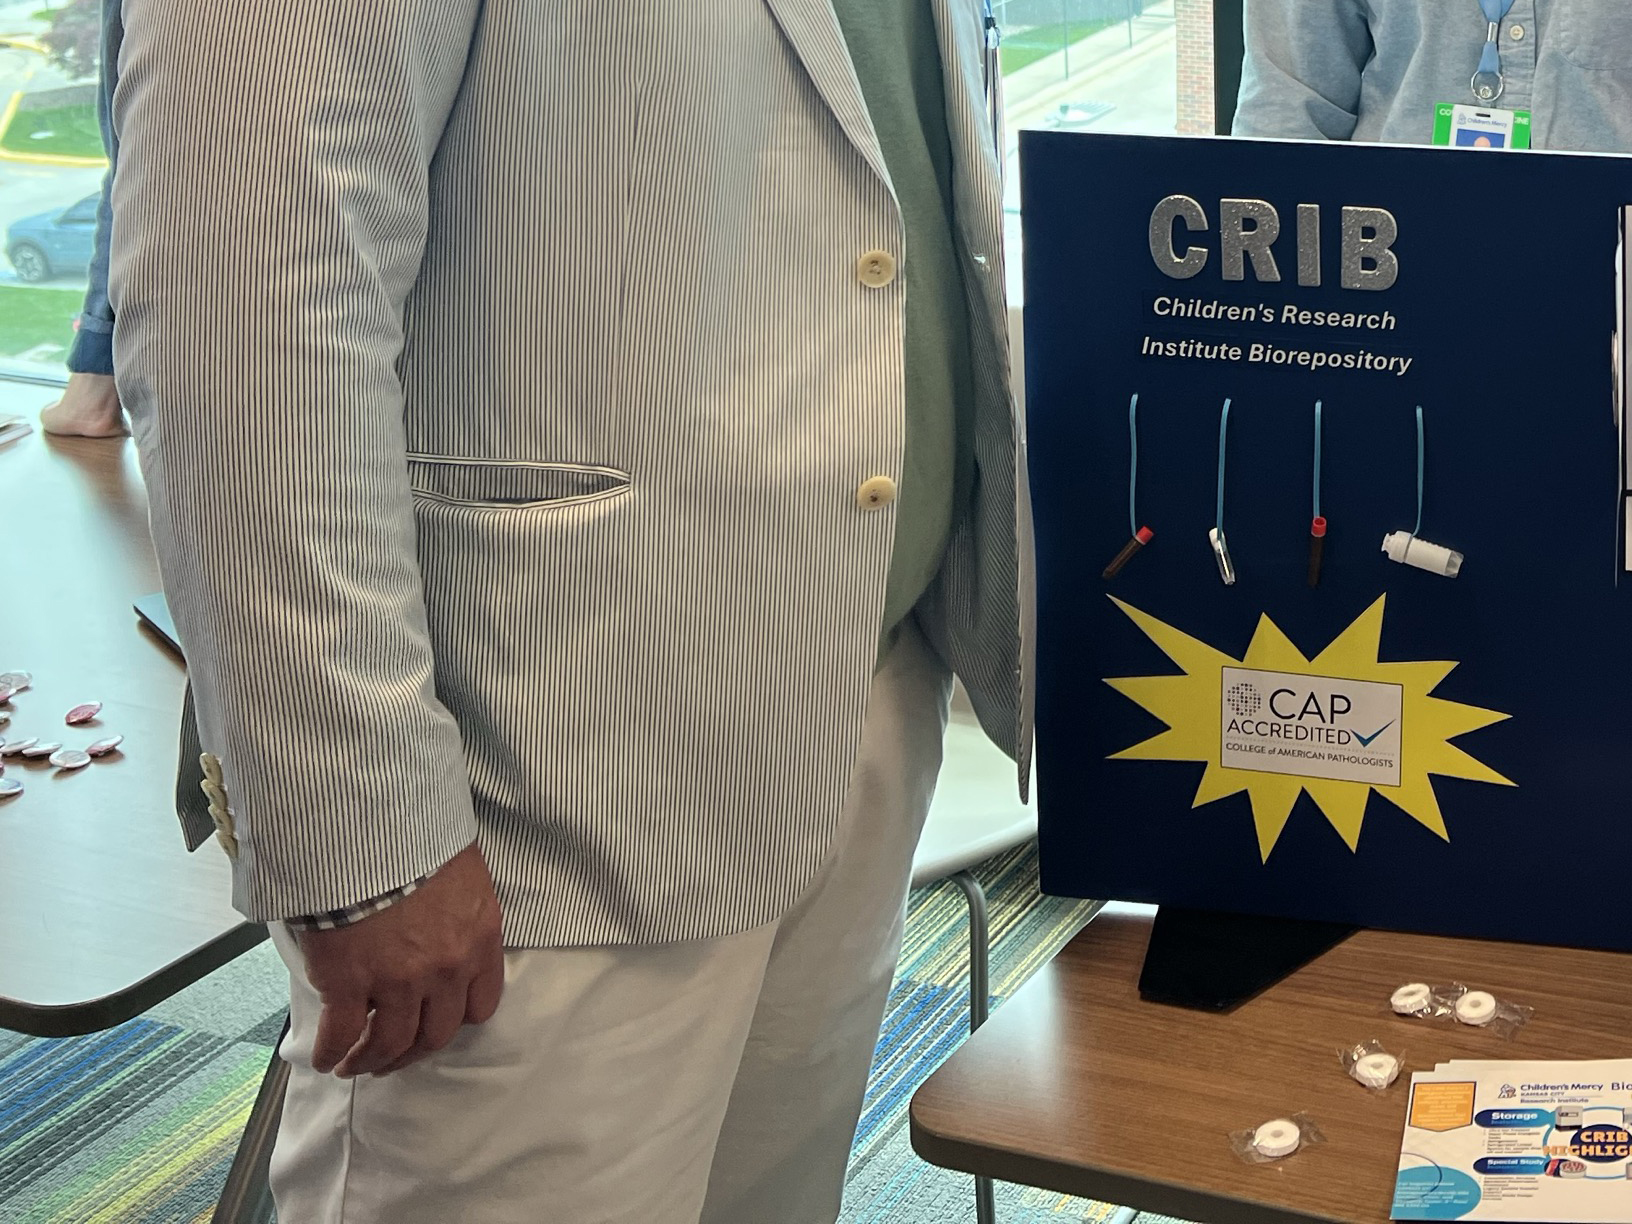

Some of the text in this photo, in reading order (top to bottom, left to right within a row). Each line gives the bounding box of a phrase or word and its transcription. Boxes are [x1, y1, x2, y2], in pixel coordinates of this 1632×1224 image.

[1148, 194, 1400, 291] CRIB
[1153, 296, 1396, 330] Children's Research
[1142, 336, 1412, 376] Institute Biorepository
[1269, 688, 1351, 724] CAP
[1227, 718, 1351, 745] ACCREDITED
[1226, 742, 1393, 768] COLLEGE of AMERICAN PATHOLOGISTS
[1520, 1083, 1603, 1092] Children's Mercy
[1492, 1112, 1538, 1120] Storage
[1580, 1131, 1629, 1143] CRIB
